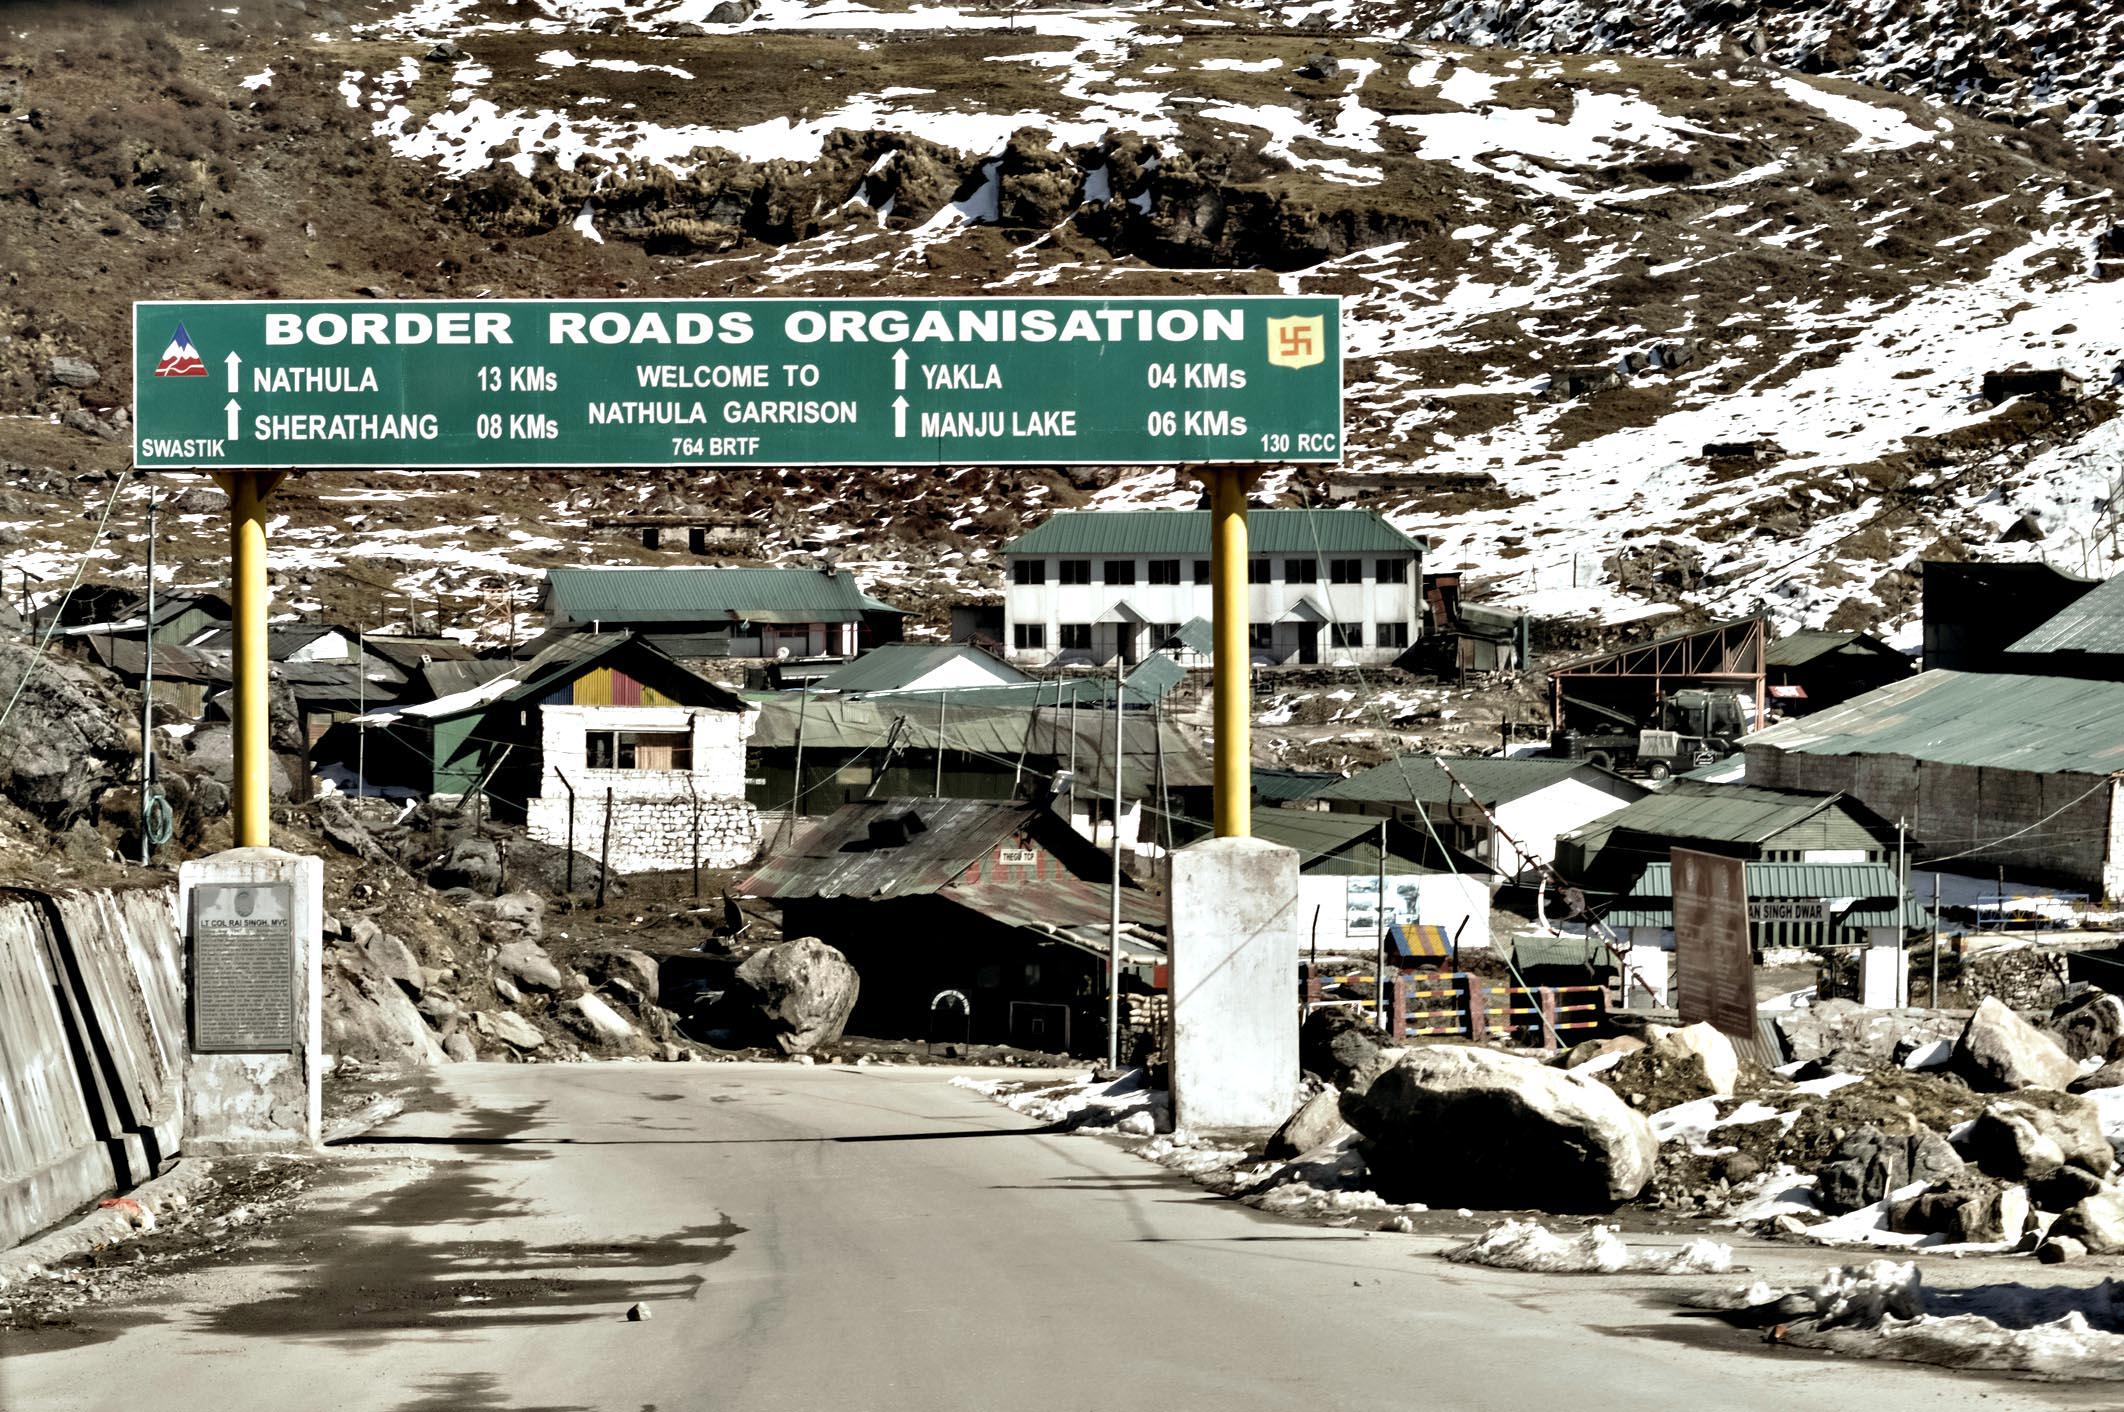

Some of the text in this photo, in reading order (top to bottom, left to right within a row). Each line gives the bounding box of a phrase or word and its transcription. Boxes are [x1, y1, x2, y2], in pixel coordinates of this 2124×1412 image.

[265, 308, 1244, 346] BORDER ROADS ORGANISATION
[253, 366, 558, 393] NATHULA 13 KMs
[636, 363, 820, 388] WELCOME TO
[921, 362, 1247, 390] YAKLA 04 KMs
[588, 400, 857, 425] NATHULA GARRISON
[921, 410, 1248, 438] MANJU LAKE 06 KMs
[254, 413, 559, 441] SHERATHANG 08 KMs
[141, 438, 225, 458] SWASTIK
[671, 436, 761, 456] 764 BRTF
[1260, 433, 1336, 453] 130 RCC
[201, 919, 209, 927] LT
[211, 919, 227, 927] COL
[229, 919, 242, 927] RAI
[271, 918, 288, 927] MVC
[1763, 904, 1793, 919] SINGH
[1795, 904, 1823, 919] DWAR
